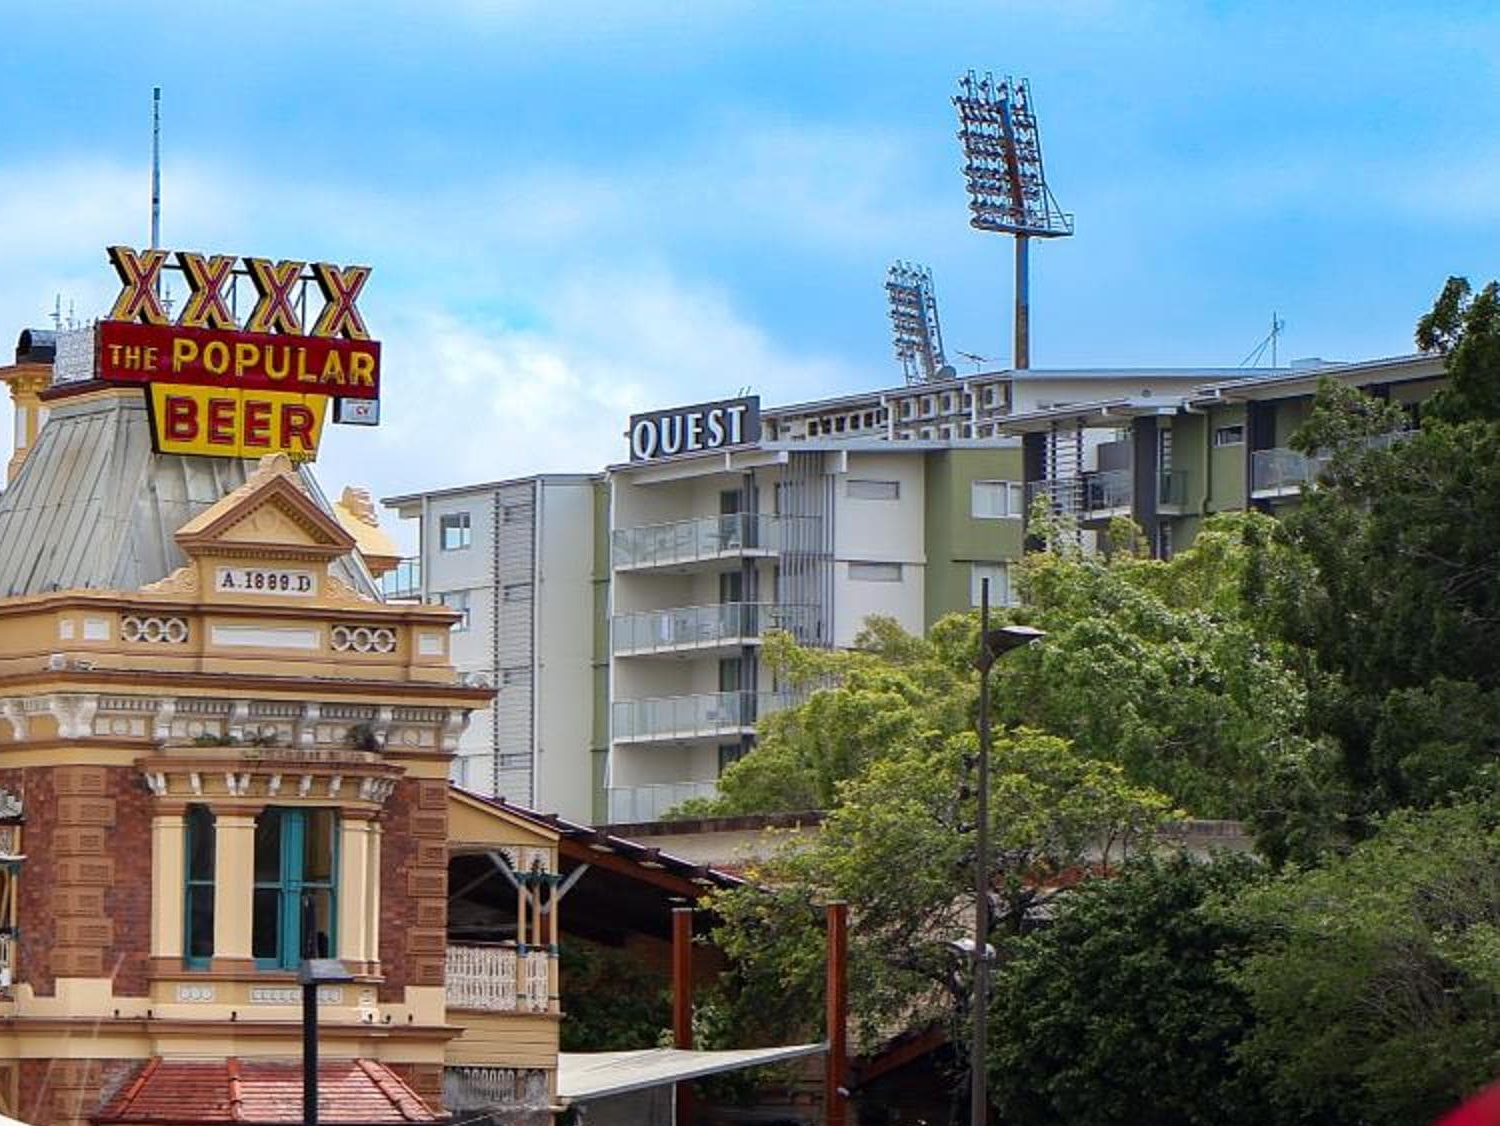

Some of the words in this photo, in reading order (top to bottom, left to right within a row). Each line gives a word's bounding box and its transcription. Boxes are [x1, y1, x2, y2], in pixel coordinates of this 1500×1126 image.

[107, 247, 372, 340] XXXX
[107, 344, 158, 371] THE
[172, 338, 376, 387] POPULAR
[164, 394, 316, 451] BEER
[632, 405, 747, 461] QUEST
